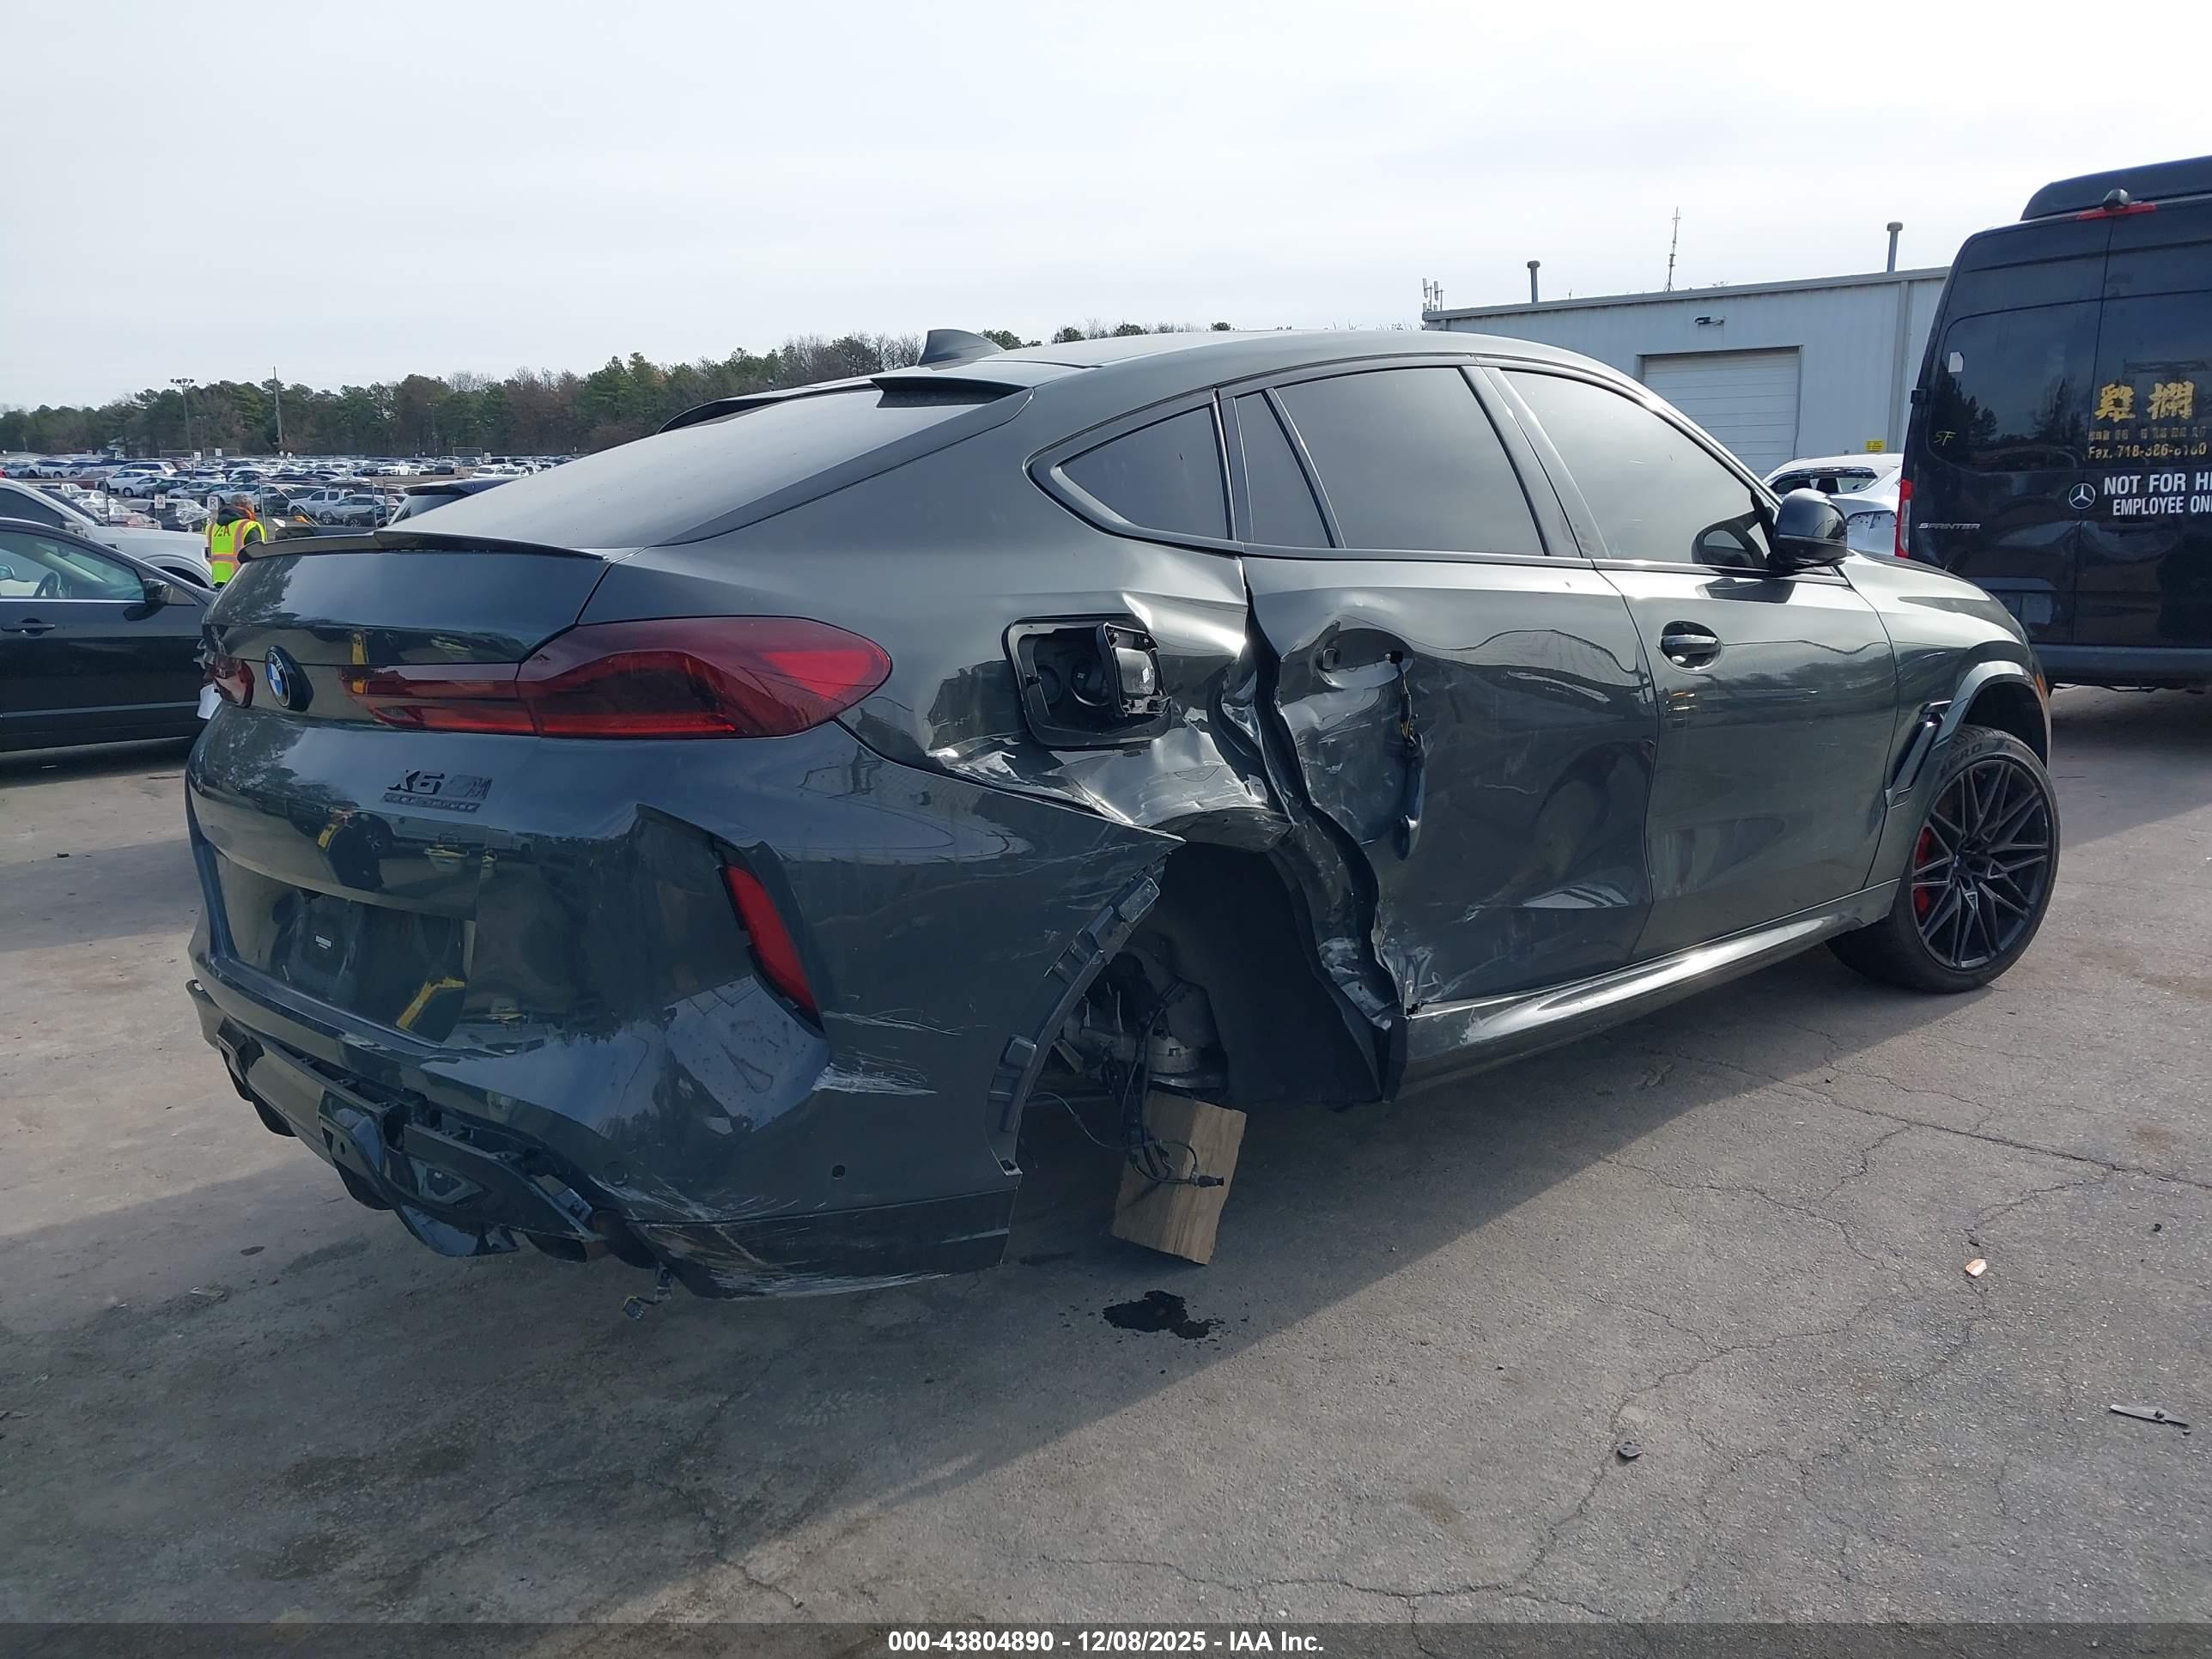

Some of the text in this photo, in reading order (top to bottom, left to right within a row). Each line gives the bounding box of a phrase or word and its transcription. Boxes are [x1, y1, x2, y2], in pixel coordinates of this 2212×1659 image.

[2087, 446, 2113, 459] Fax.
[2103, 475, 2142, 495] NOT
[2148, 472, 2186, 494] FOR
[210, 499, 216, 508] R
[2112, 495, 2185, 516] EMPLOYEE
[1917, 522, 1981, 531] SPRINTER
